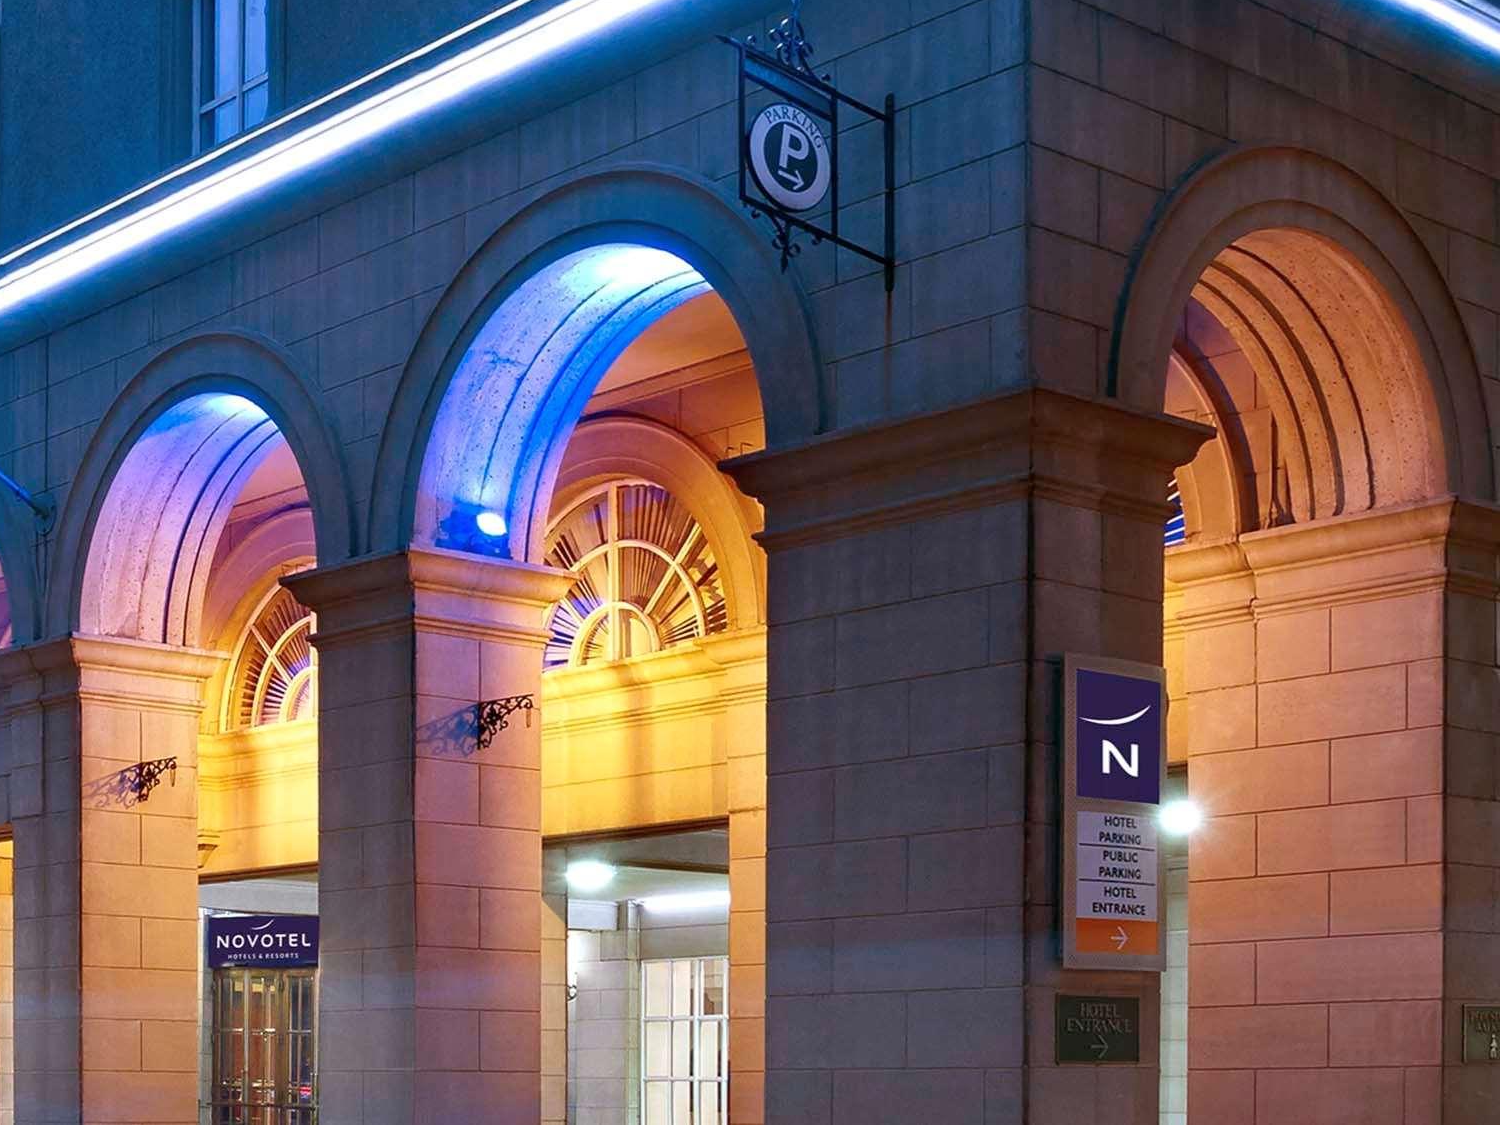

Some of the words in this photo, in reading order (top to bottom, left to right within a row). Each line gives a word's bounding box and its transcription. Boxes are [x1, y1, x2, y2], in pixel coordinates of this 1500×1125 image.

[764, 106, 822, 148] PARKING
[779, 124, 809, 168] P
[1102, 739, 1139, 777] N
[1104, 816, 1137, 829] HOTEL
[1099, 832, 1141, 845] PARKING
[1103, 850, 1138, 863] PUBLIC
[1099, 866, 1141, 879] PARKING
[1104, 886, 1137, 899] HOTEL
[1092, 902, 1146, 915] ENTRANCE
[216, 933, 311, 948] NOVOTEL
[1080, 1002, 1120, 1018] HOTEL
[1067, 1018, 1132, 1034] ENTRANCE
